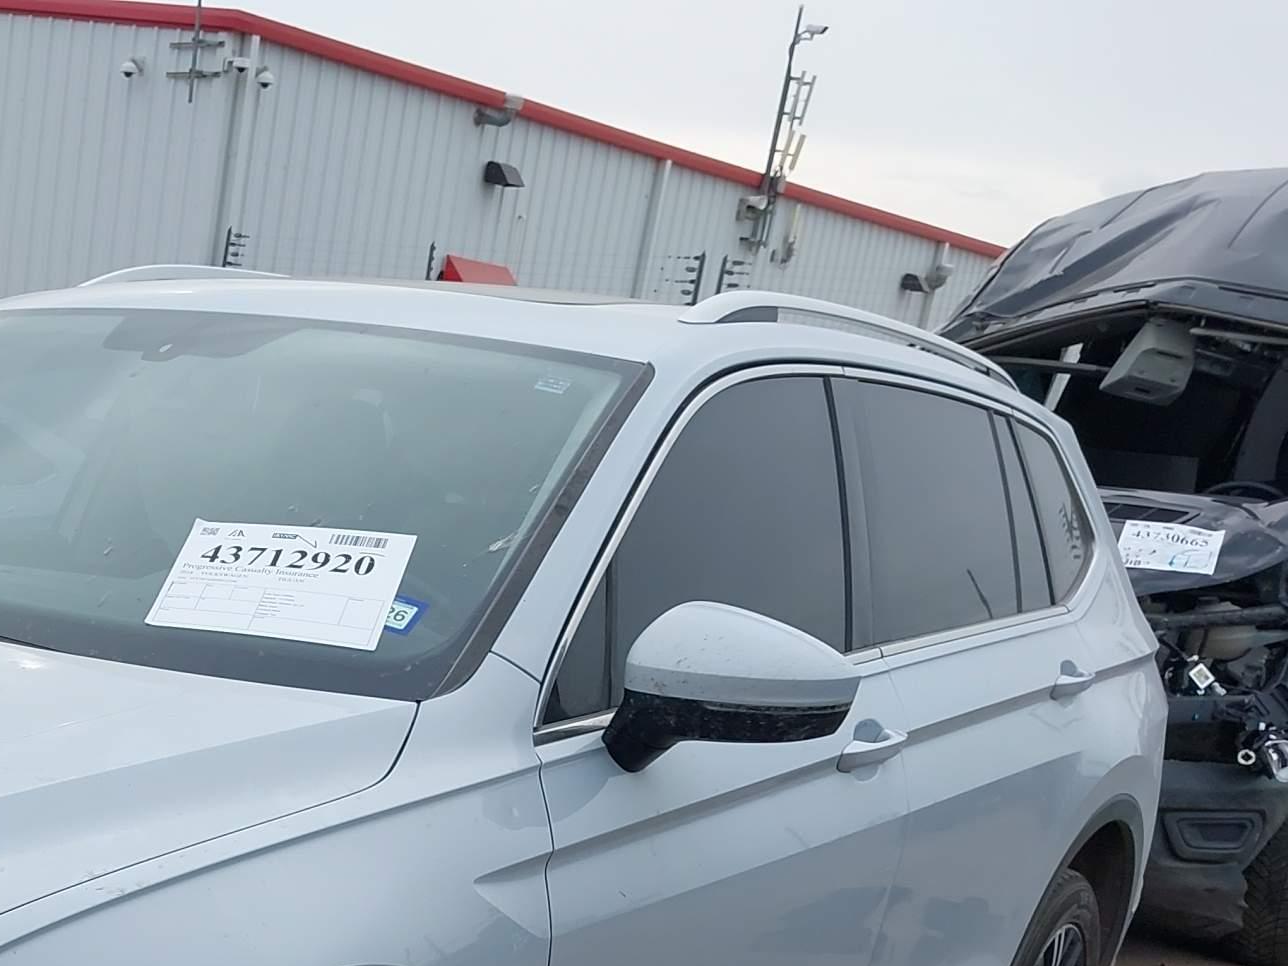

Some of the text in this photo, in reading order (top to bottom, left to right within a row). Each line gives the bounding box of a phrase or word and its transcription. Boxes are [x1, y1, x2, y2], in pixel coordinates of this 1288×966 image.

[182, 562, 233, 572] Progressive
[234, 566, 273, 576] Casualty
[275, 569, 319, 579] Insurance
[200, 544, 375, 576] 43712920
